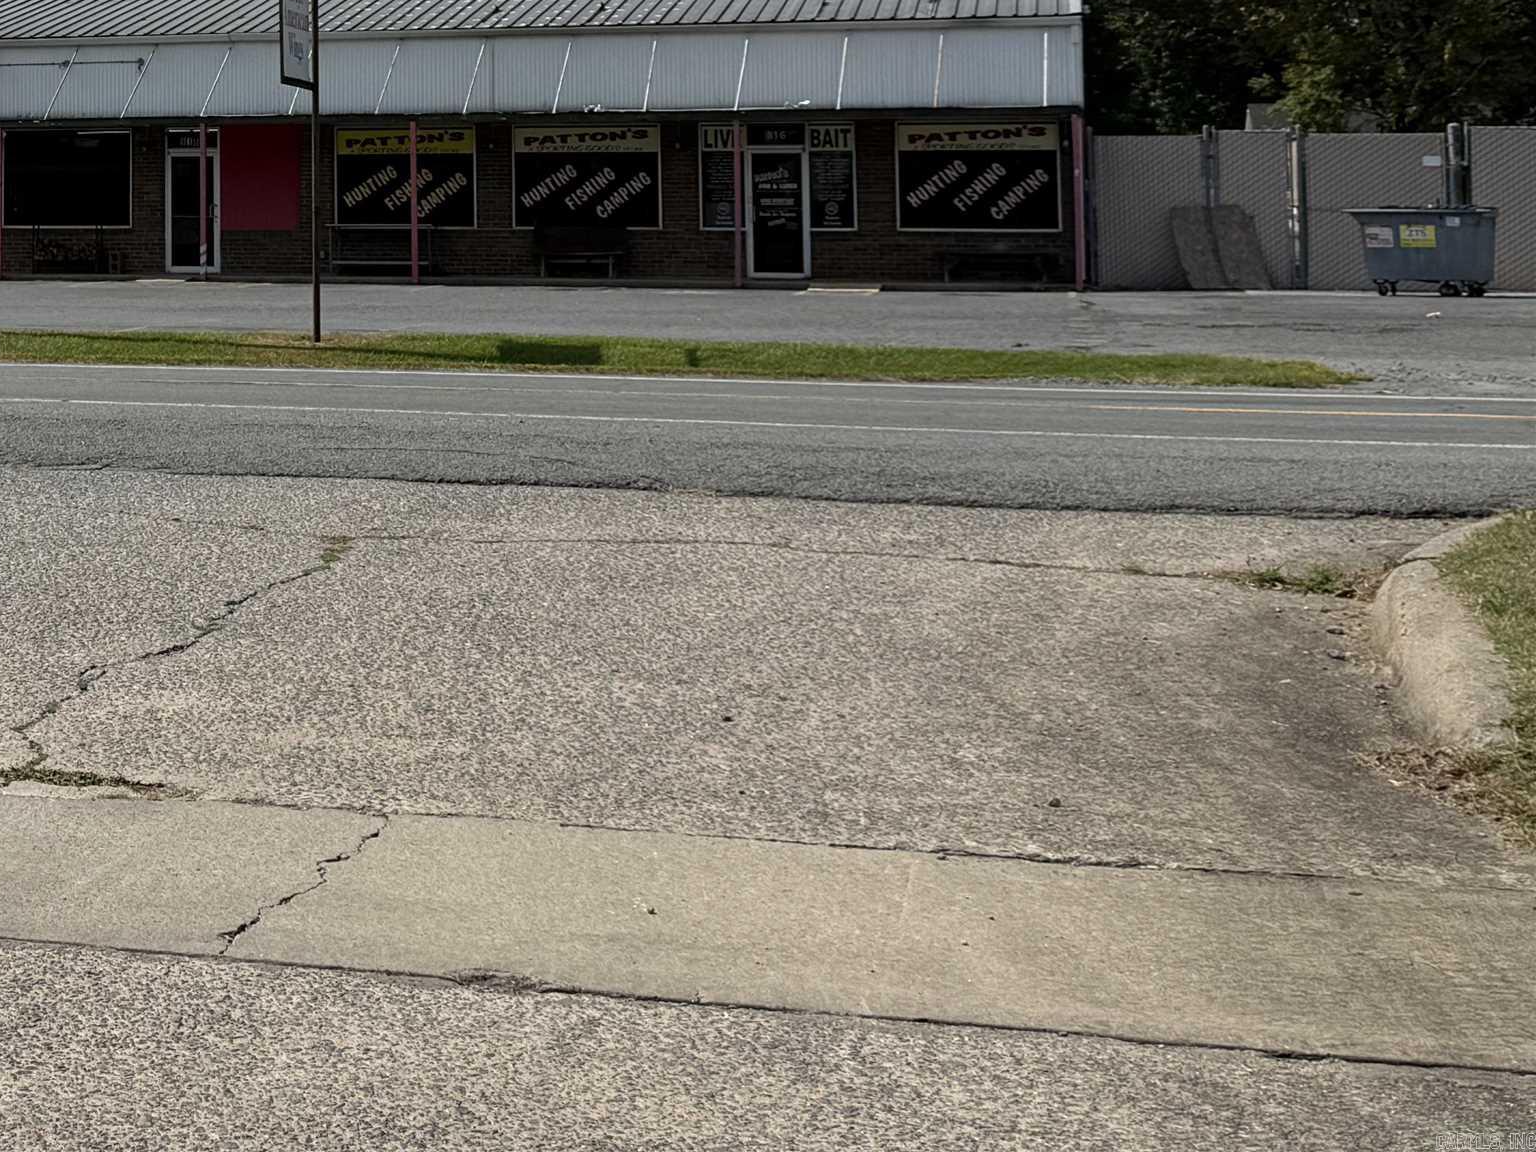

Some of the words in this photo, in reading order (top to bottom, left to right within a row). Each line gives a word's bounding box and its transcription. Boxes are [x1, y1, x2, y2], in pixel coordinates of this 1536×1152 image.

[345, 130, 465, 148] PATTON'S
[523, 128, 649, 146] PATTON'S
[811, 129, 850, 148] BAIT
[907, 125, 1047, 144] PATTON'S
[342, 164, 398, 208] HUNTING
[520, 164, 577, 208] HUNTING
[564, 167, 616, 211] FISHING
[595, 171, 652, 219] CAMPING
[906, 160, 968, 208] HUNTING
[952, 162, 1008, 212] FISHING
[989, 168, 1050, 220] CAMPING
